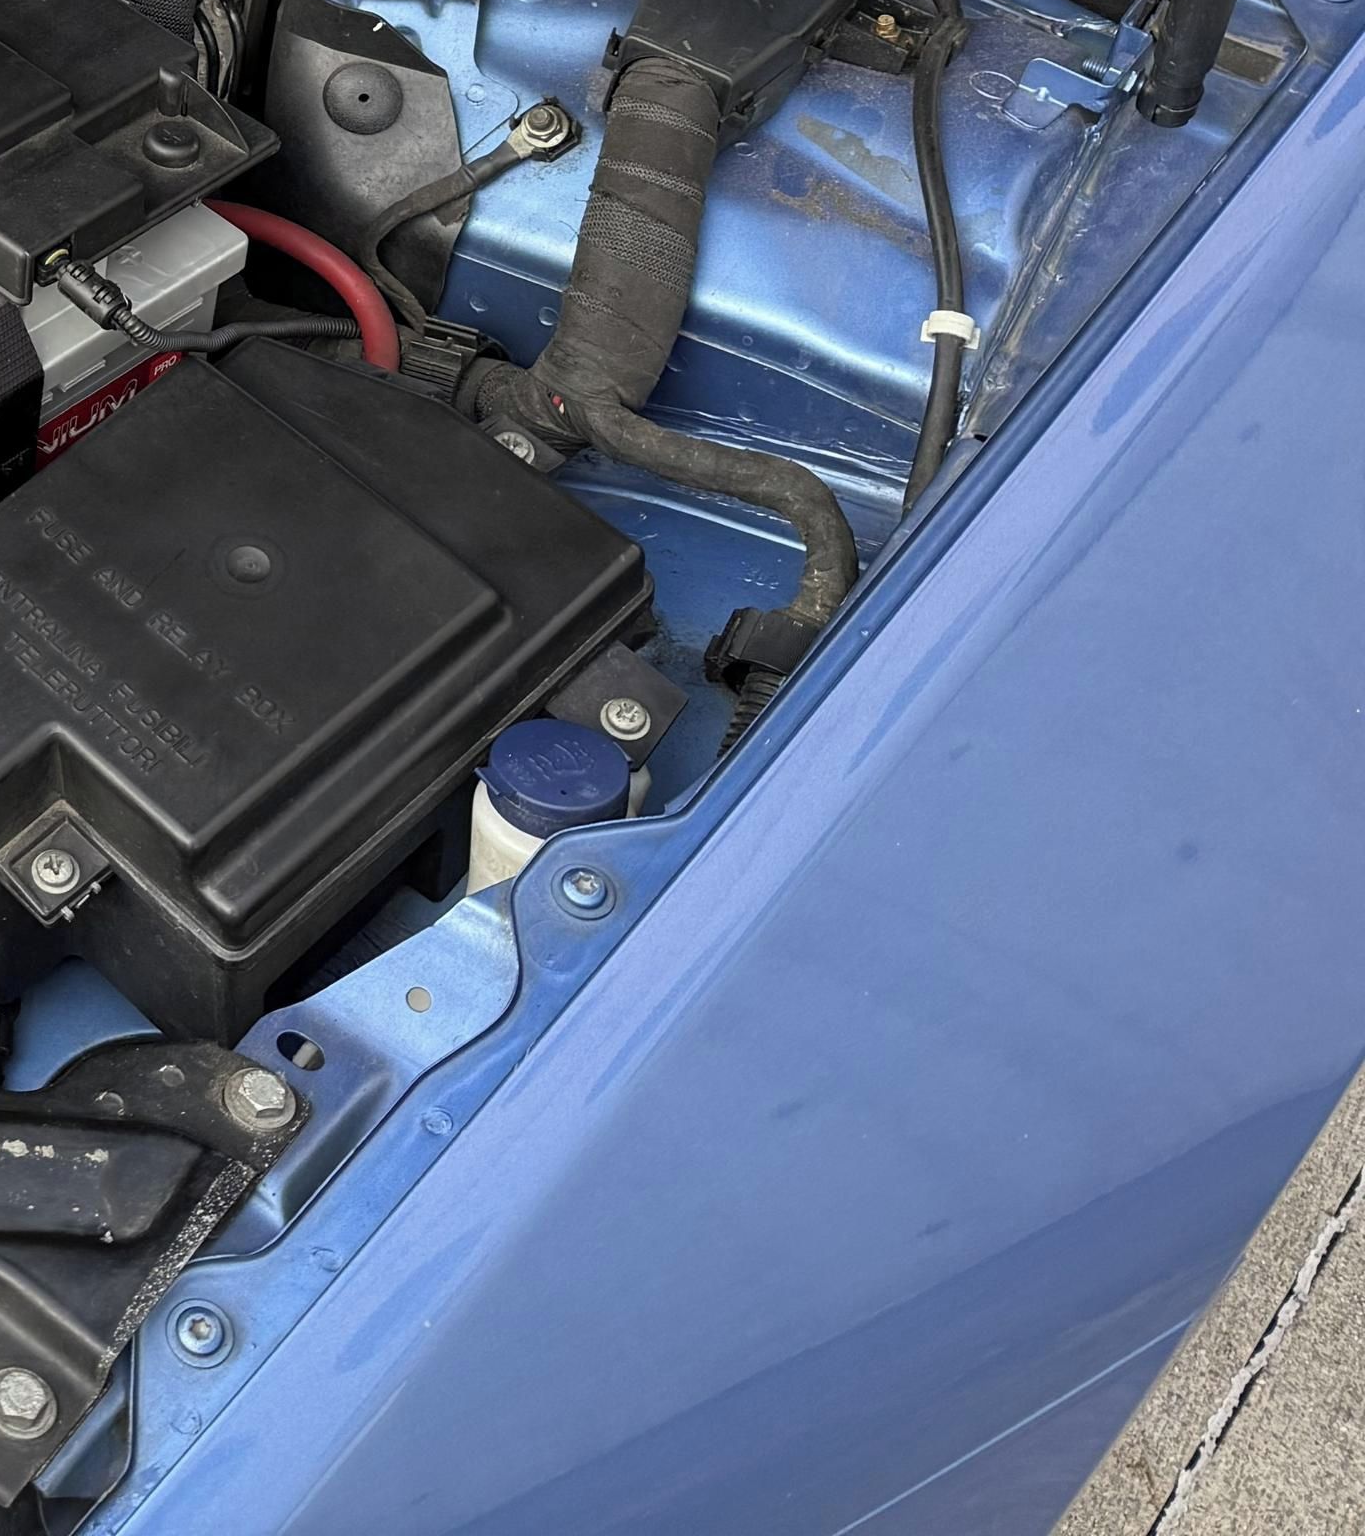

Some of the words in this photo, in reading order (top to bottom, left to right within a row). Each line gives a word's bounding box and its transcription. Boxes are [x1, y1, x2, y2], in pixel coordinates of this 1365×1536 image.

[153, 354, 178, 377] PRO
[28, 509, 93, 563] FUSE
[92, 568, 146, 609] AND
[145, 611, 231, 680] RELAY
[234, 684, 295, 734] BOX
[4, 630, 163, 774] TELERUTTORI
[111, 682, 207, 768] FUSIBILI
